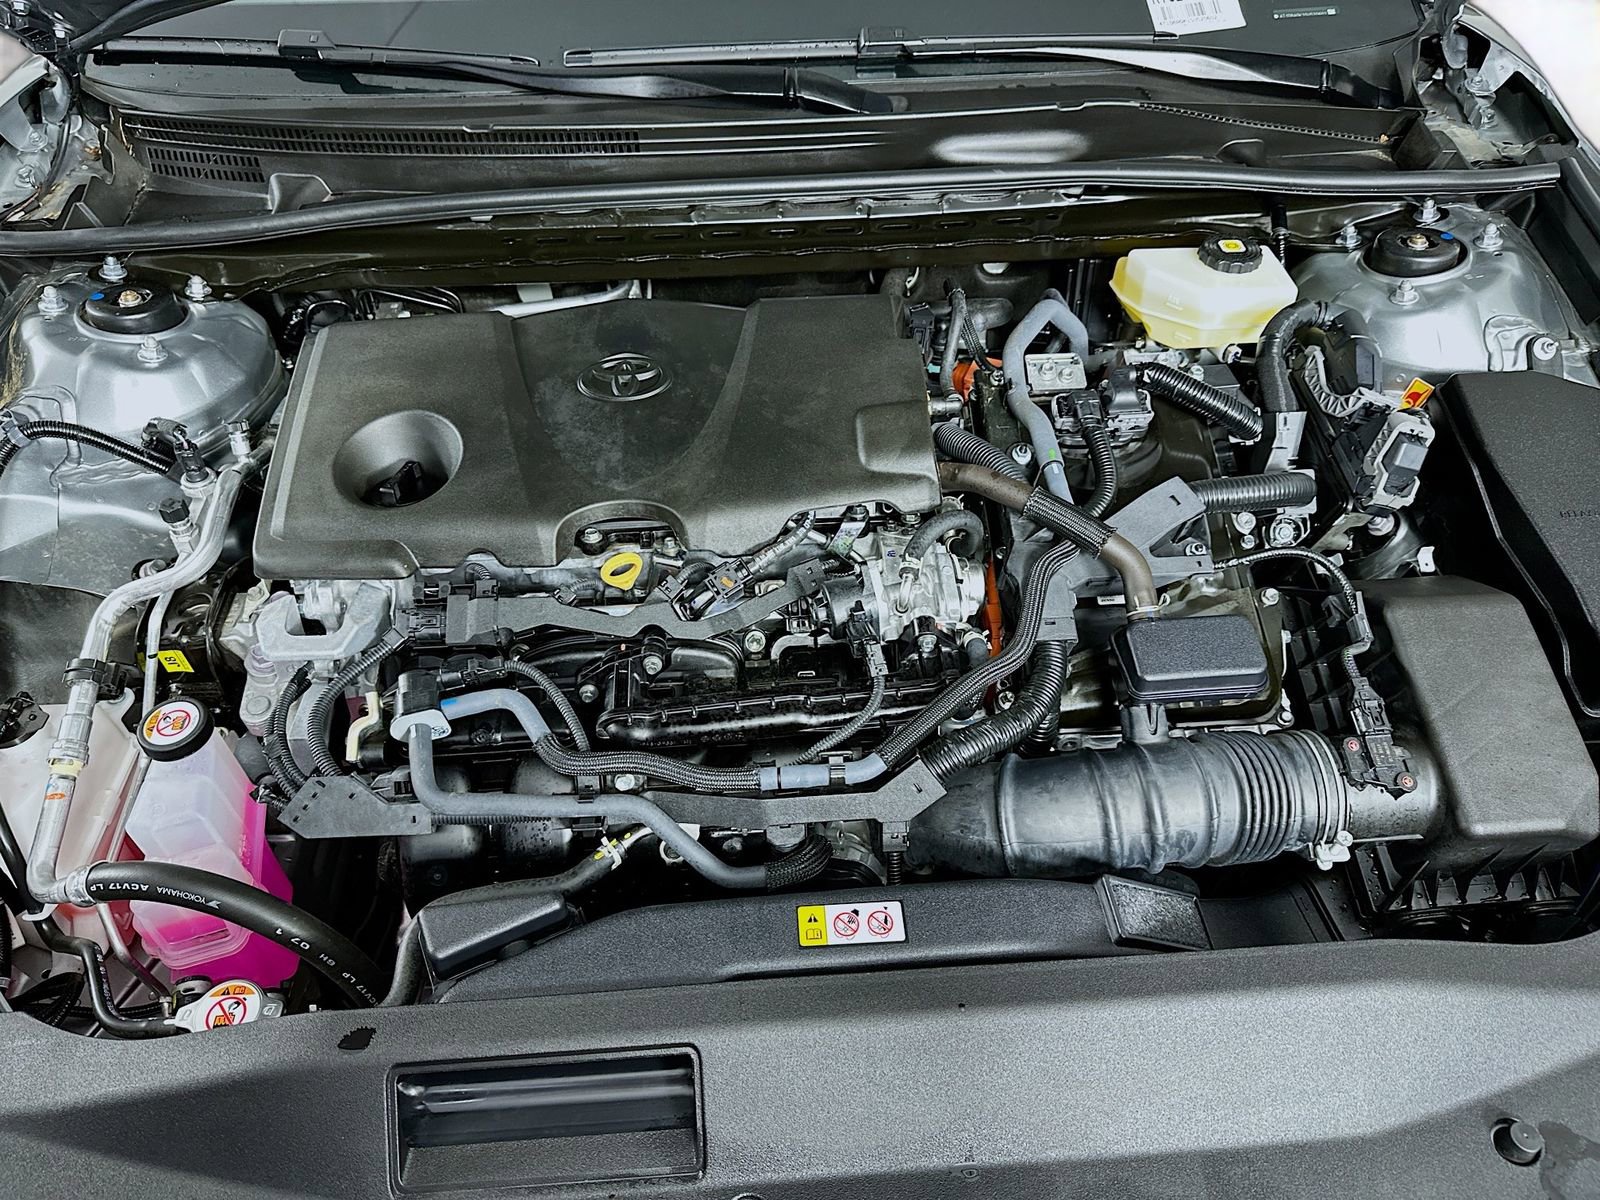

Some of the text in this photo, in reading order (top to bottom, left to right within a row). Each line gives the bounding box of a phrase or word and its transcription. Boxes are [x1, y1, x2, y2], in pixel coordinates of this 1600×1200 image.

[164, 656, 181, 667] J8
[90, 882, 103, 891] LP
[108, 882, 150, 891] ACV17
[156, 886, 206, 904] YOKOHAMA
[341, 971, 356, 984] LP
[356, 984, 379, 1007] CV17
